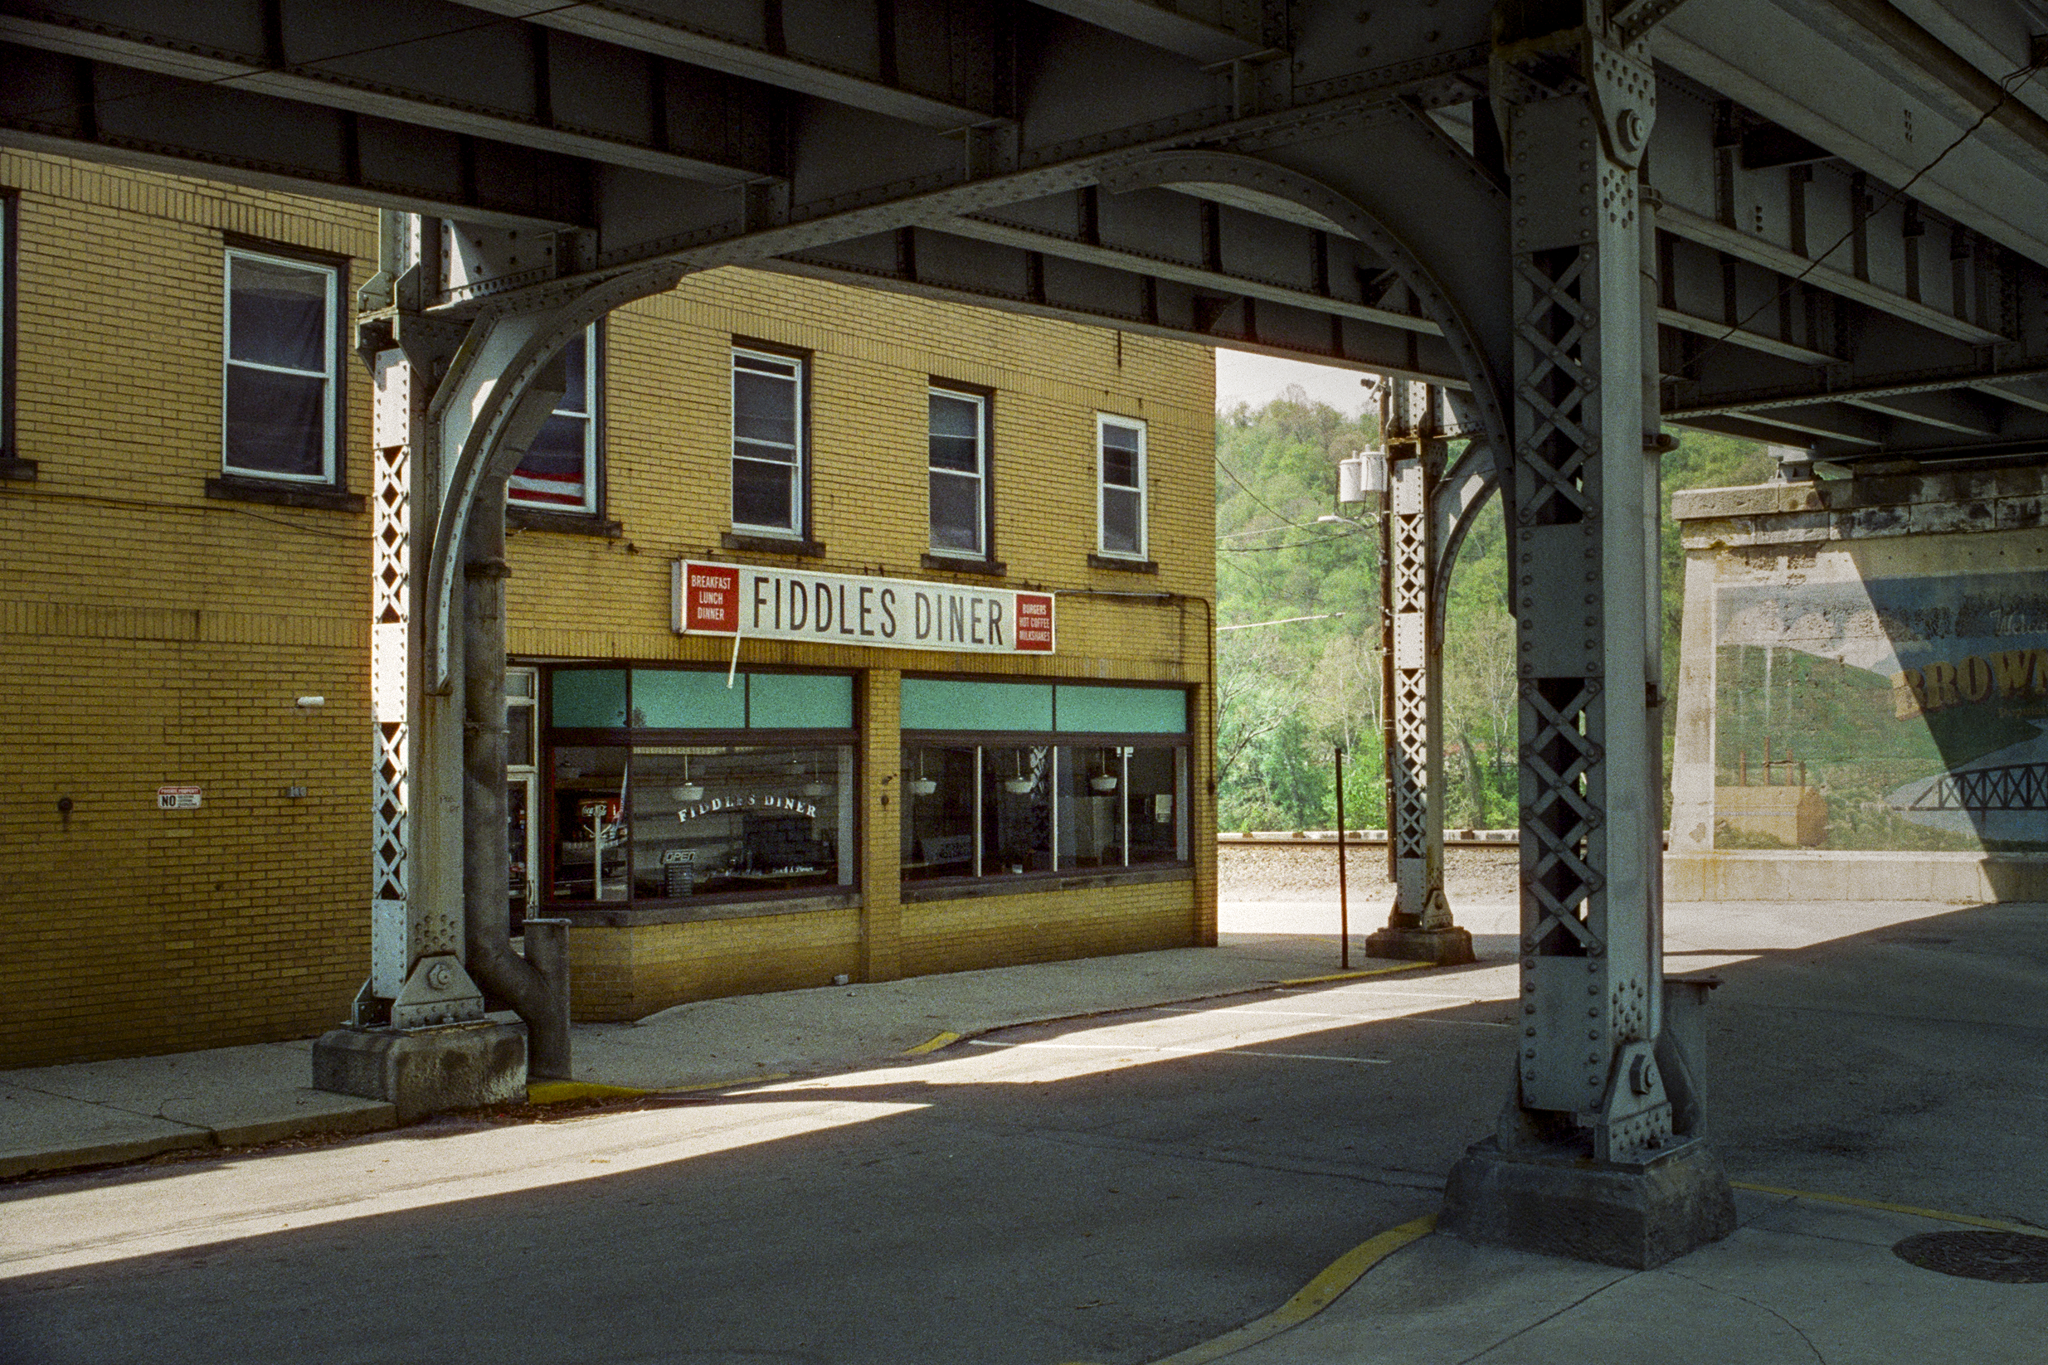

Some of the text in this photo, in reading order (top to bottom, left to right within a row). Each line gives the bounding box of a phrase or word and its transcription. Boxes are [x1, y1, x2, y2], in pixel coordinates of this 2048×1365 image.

[691, 574, 732, 590] BREAKFAST
[699, 591, 723, 605] LUNCH
[697, 606, 725, 621] DINNER
[753, 576, 1004, 646] FIDDLES DINER
[1022, 603, 1047, 616] BURGERS
[1019, 616, 1050, 629] HOT COFFEE
[1019, 630, 1050, 642] MILKSHAKES
[161, 795, 176, 807] NO
[677, 794, 818, 823] FIDDLES DINER
[665, 850, 696, 863] OPEN
